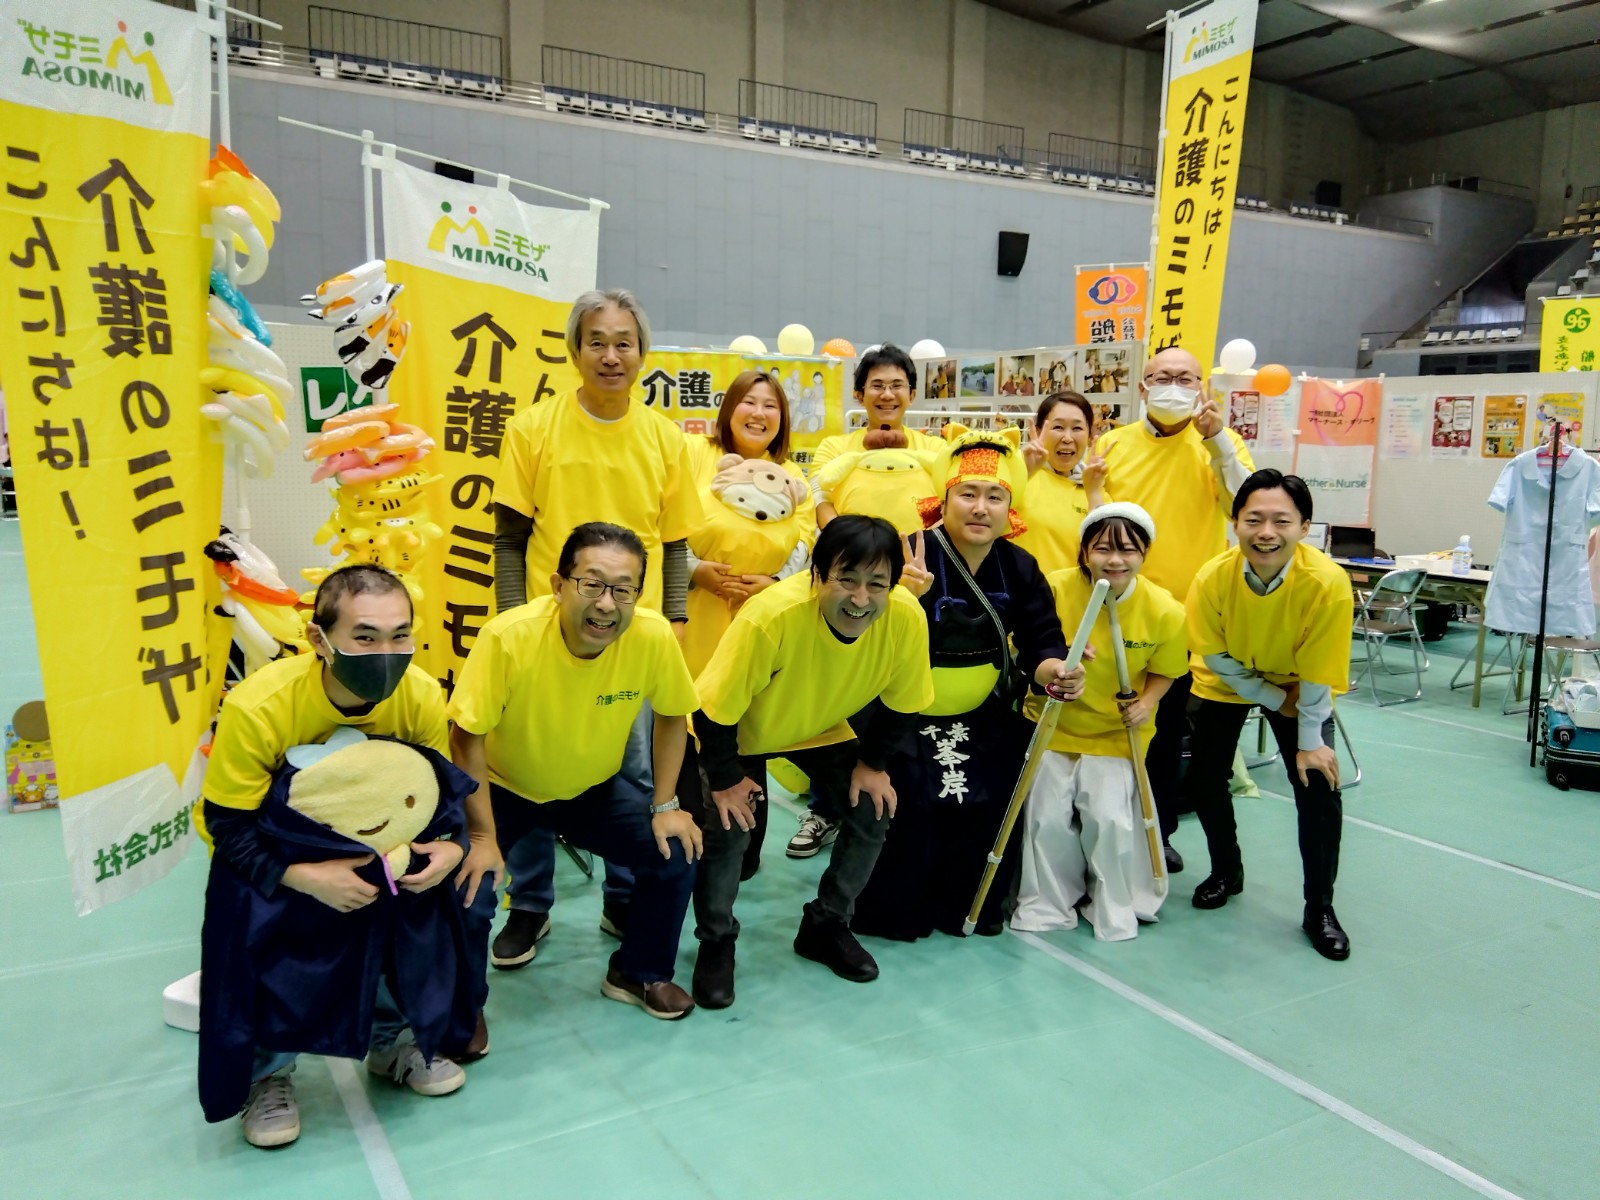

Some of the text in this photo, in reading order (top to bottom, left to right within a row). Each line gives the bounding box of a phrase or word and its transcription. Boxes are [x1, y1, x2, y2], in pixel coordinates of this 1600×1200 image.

[1192, 35, 1235, 61] MIMOSA
[493, 228, 551, 262] ミモザ
[452, 243, 549, 283] MIMOSA
[1336, 479, 1367, 488] Nurse
